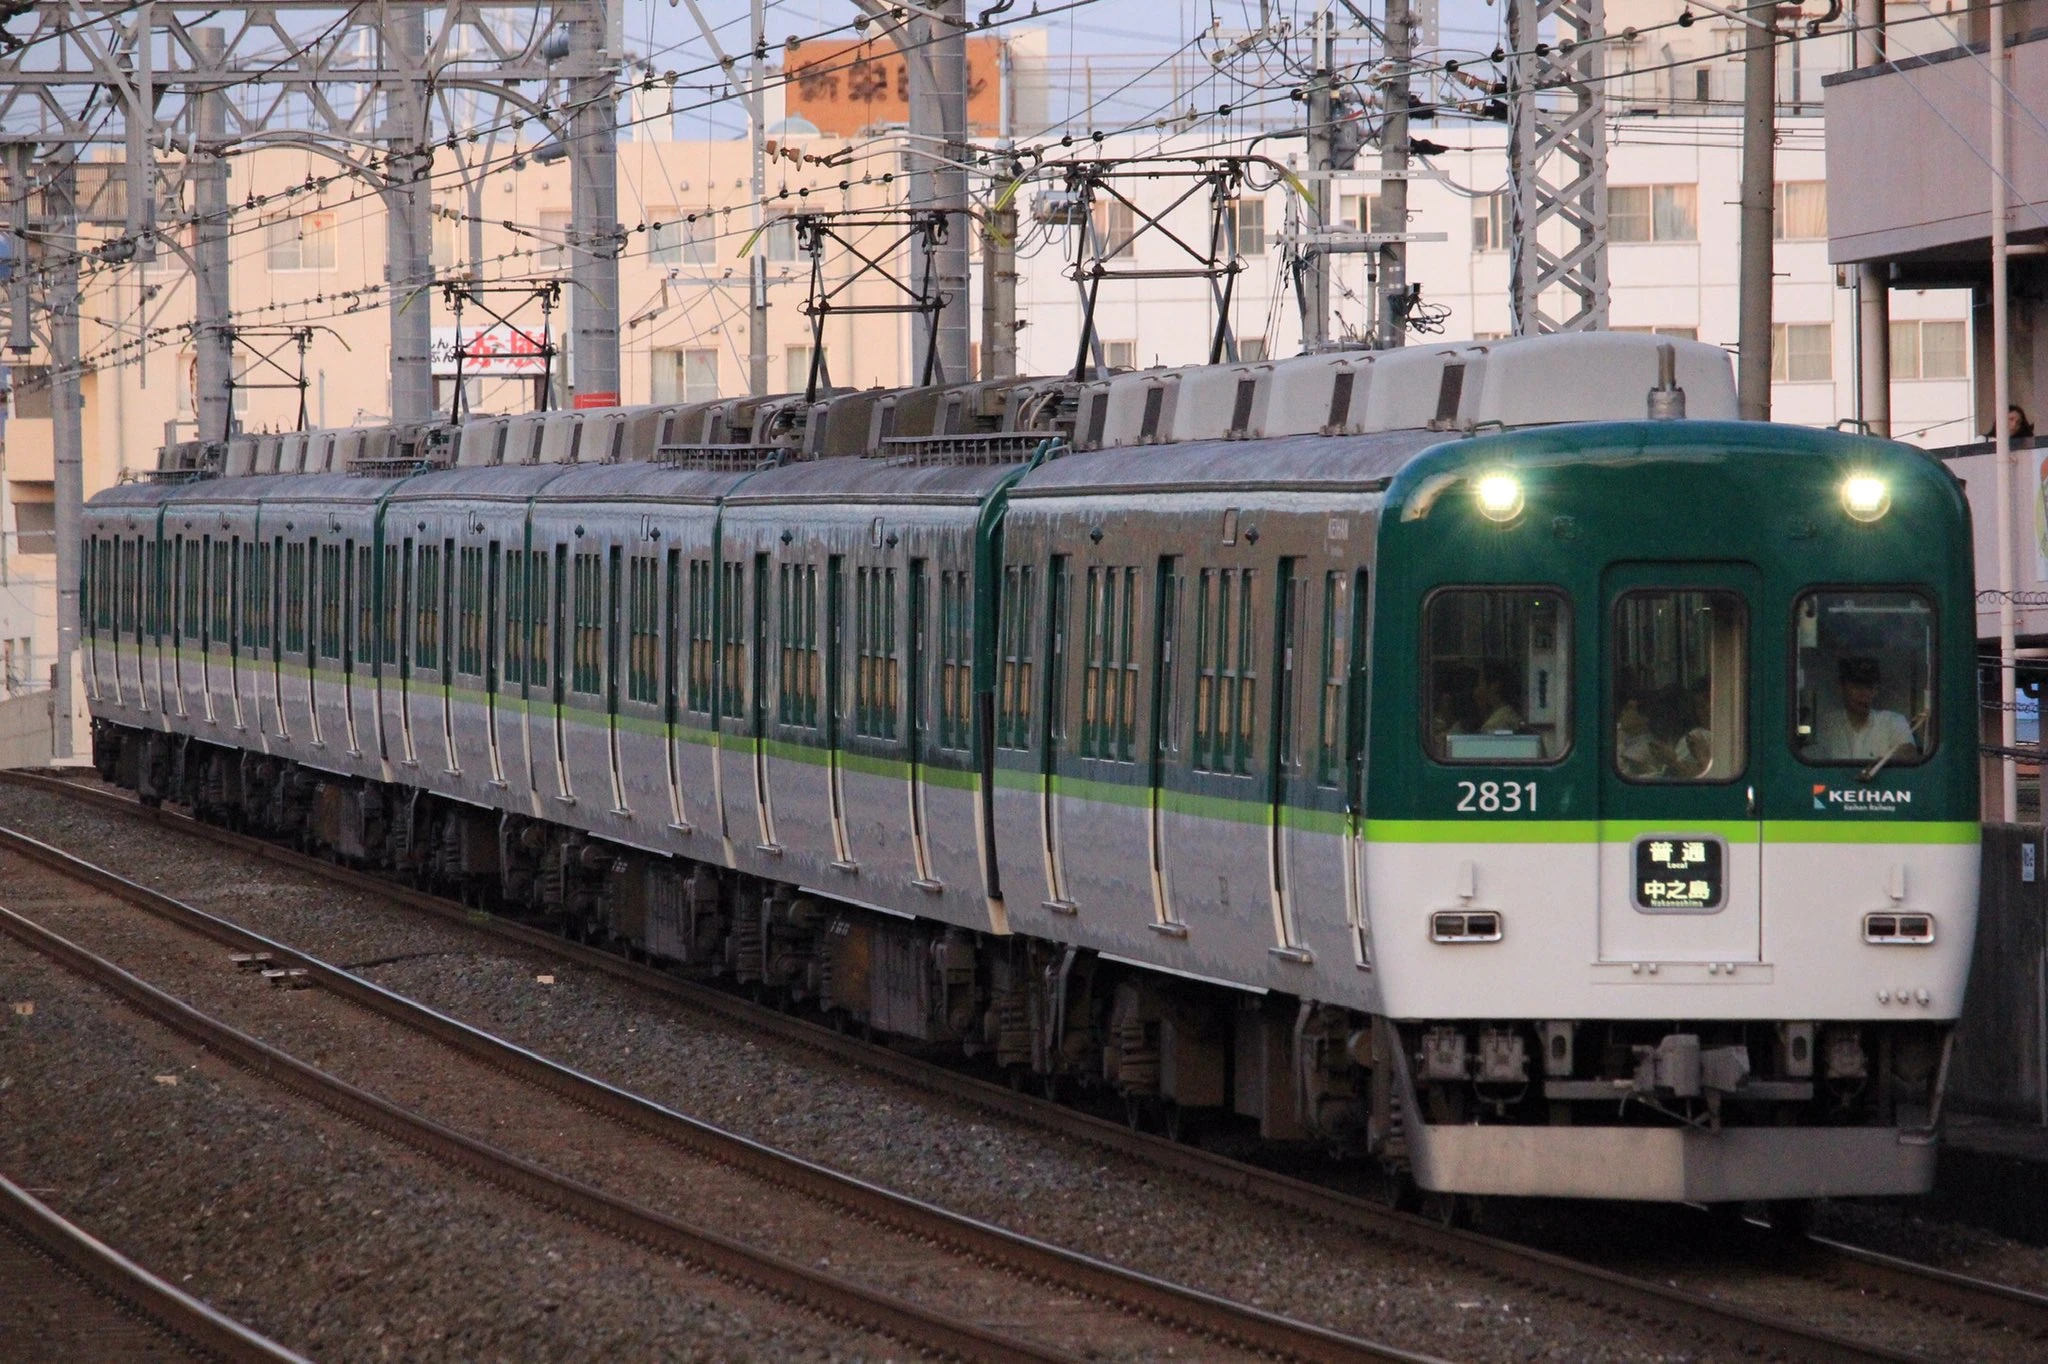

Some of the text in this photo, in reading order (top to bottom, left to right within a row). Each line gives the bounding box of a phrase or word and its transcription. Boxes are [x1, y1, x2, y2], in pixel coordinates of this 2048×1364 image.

[1456, 781, 1537, 812] 2831
[1829, 789, 1911, 803] KEIHAN
[1649, 841, 1706, 862] 普通
[1644, 880, 1710, 900] 中之島
